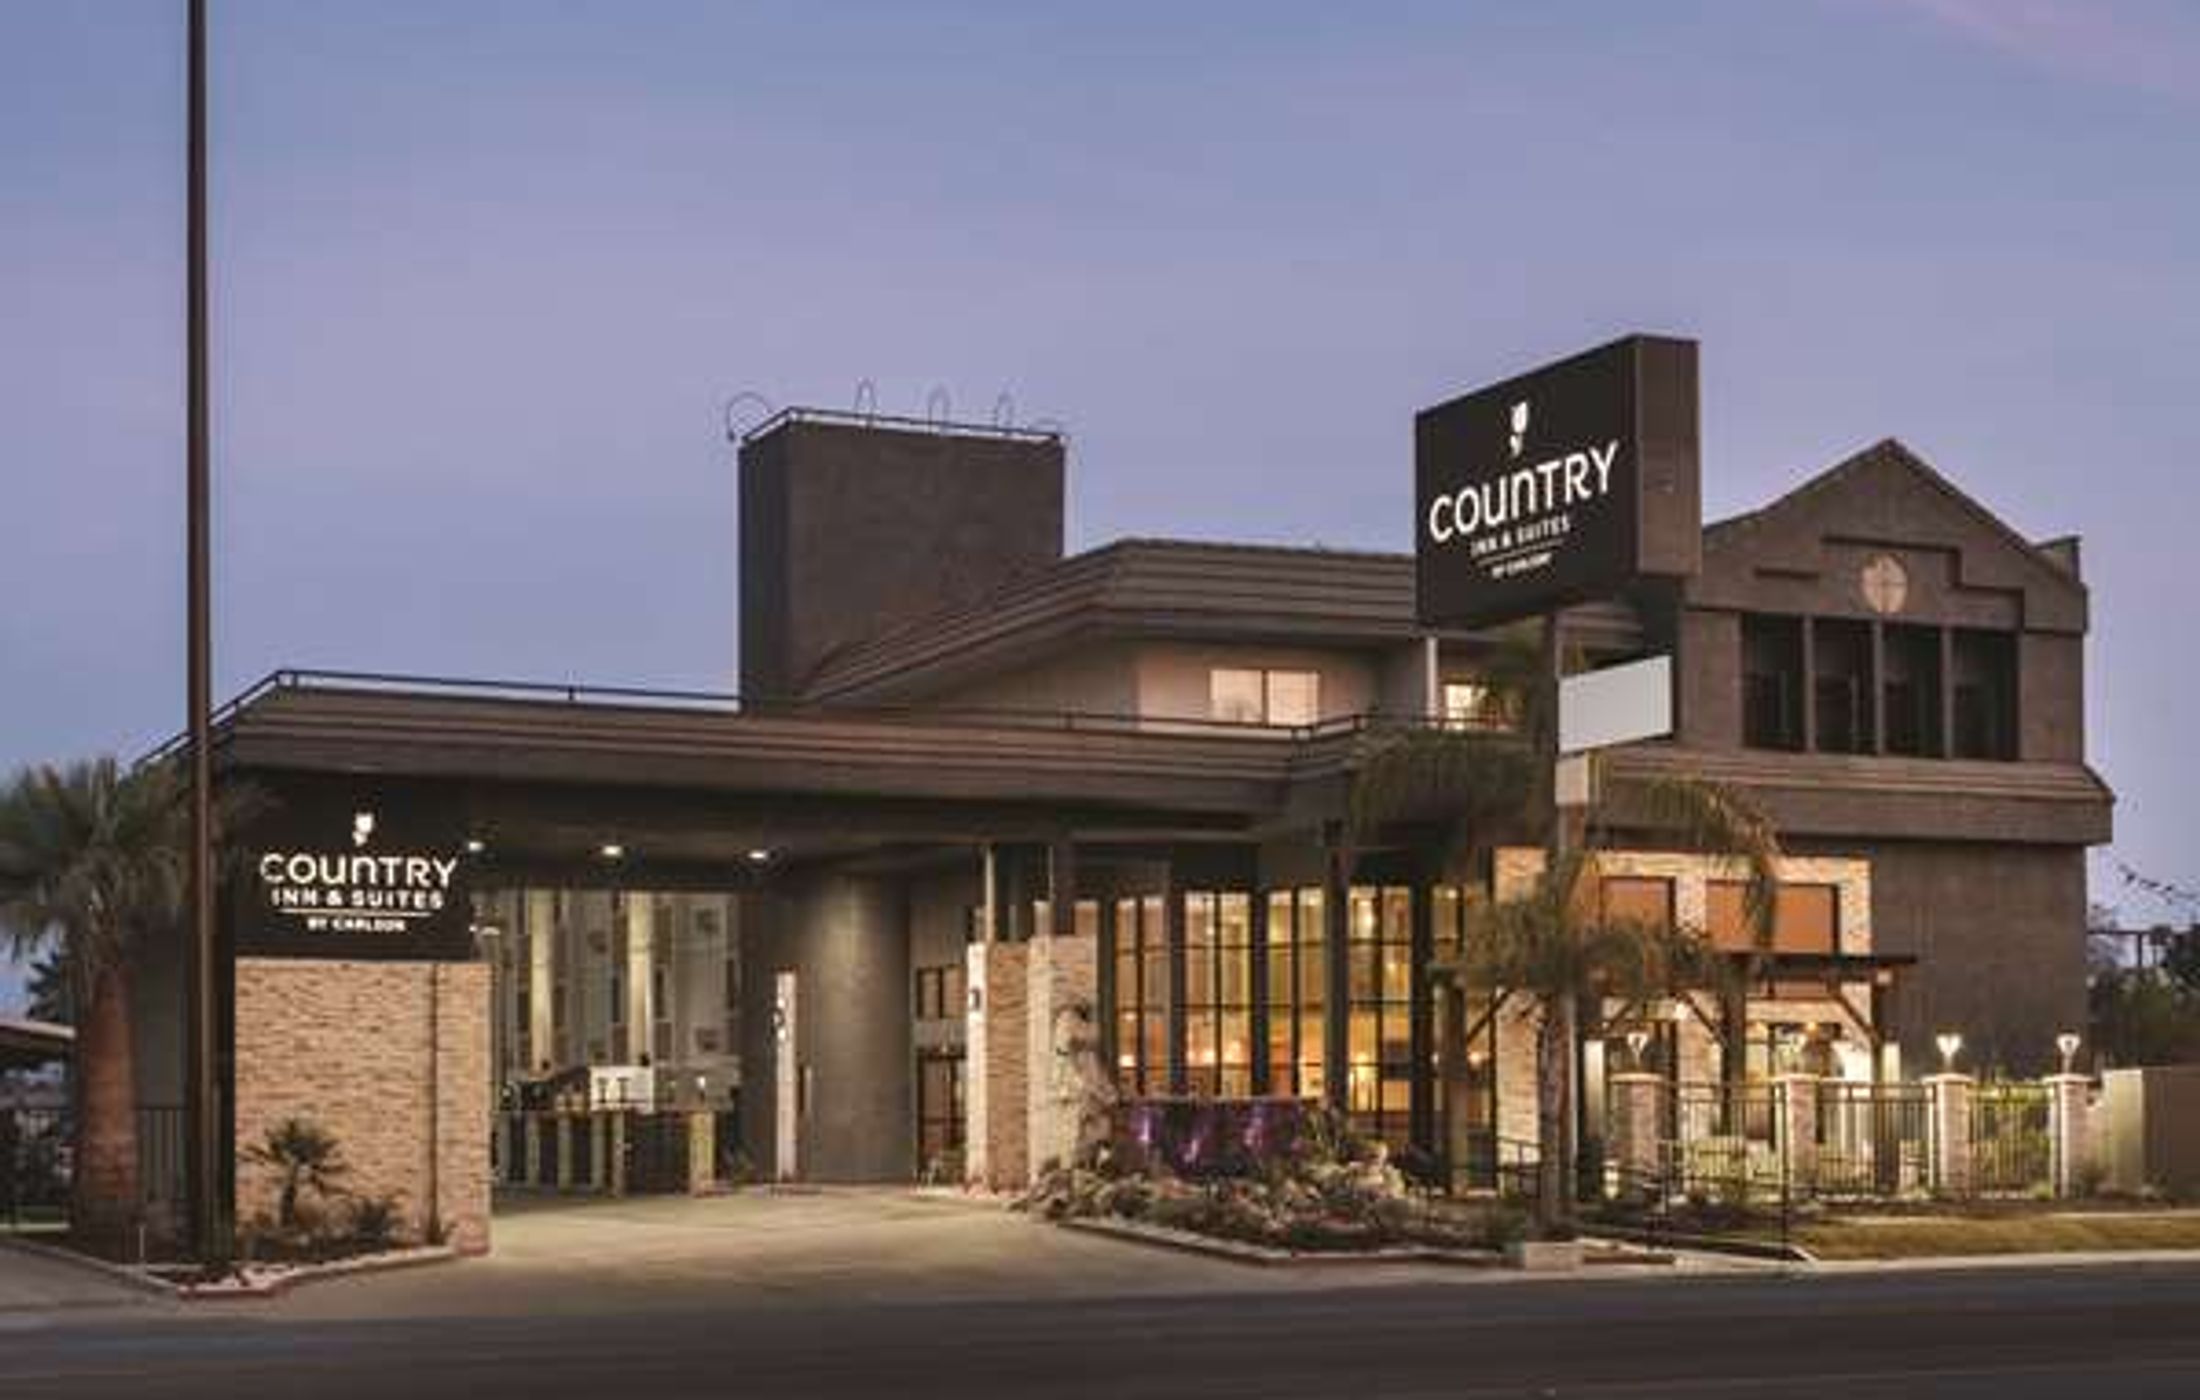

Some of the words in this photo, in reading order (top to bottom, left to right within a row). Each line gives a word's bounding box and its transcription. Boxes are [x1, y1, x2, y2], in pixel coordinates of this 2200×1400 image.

[1429, 440, 1618, 542] COUNTRY
[262, 853, 457, 886] COUNTRY
[271, 889, 317, 906] INN
[326, 889, 343, 906] &
[351, 890, 445, 910] SUITES
